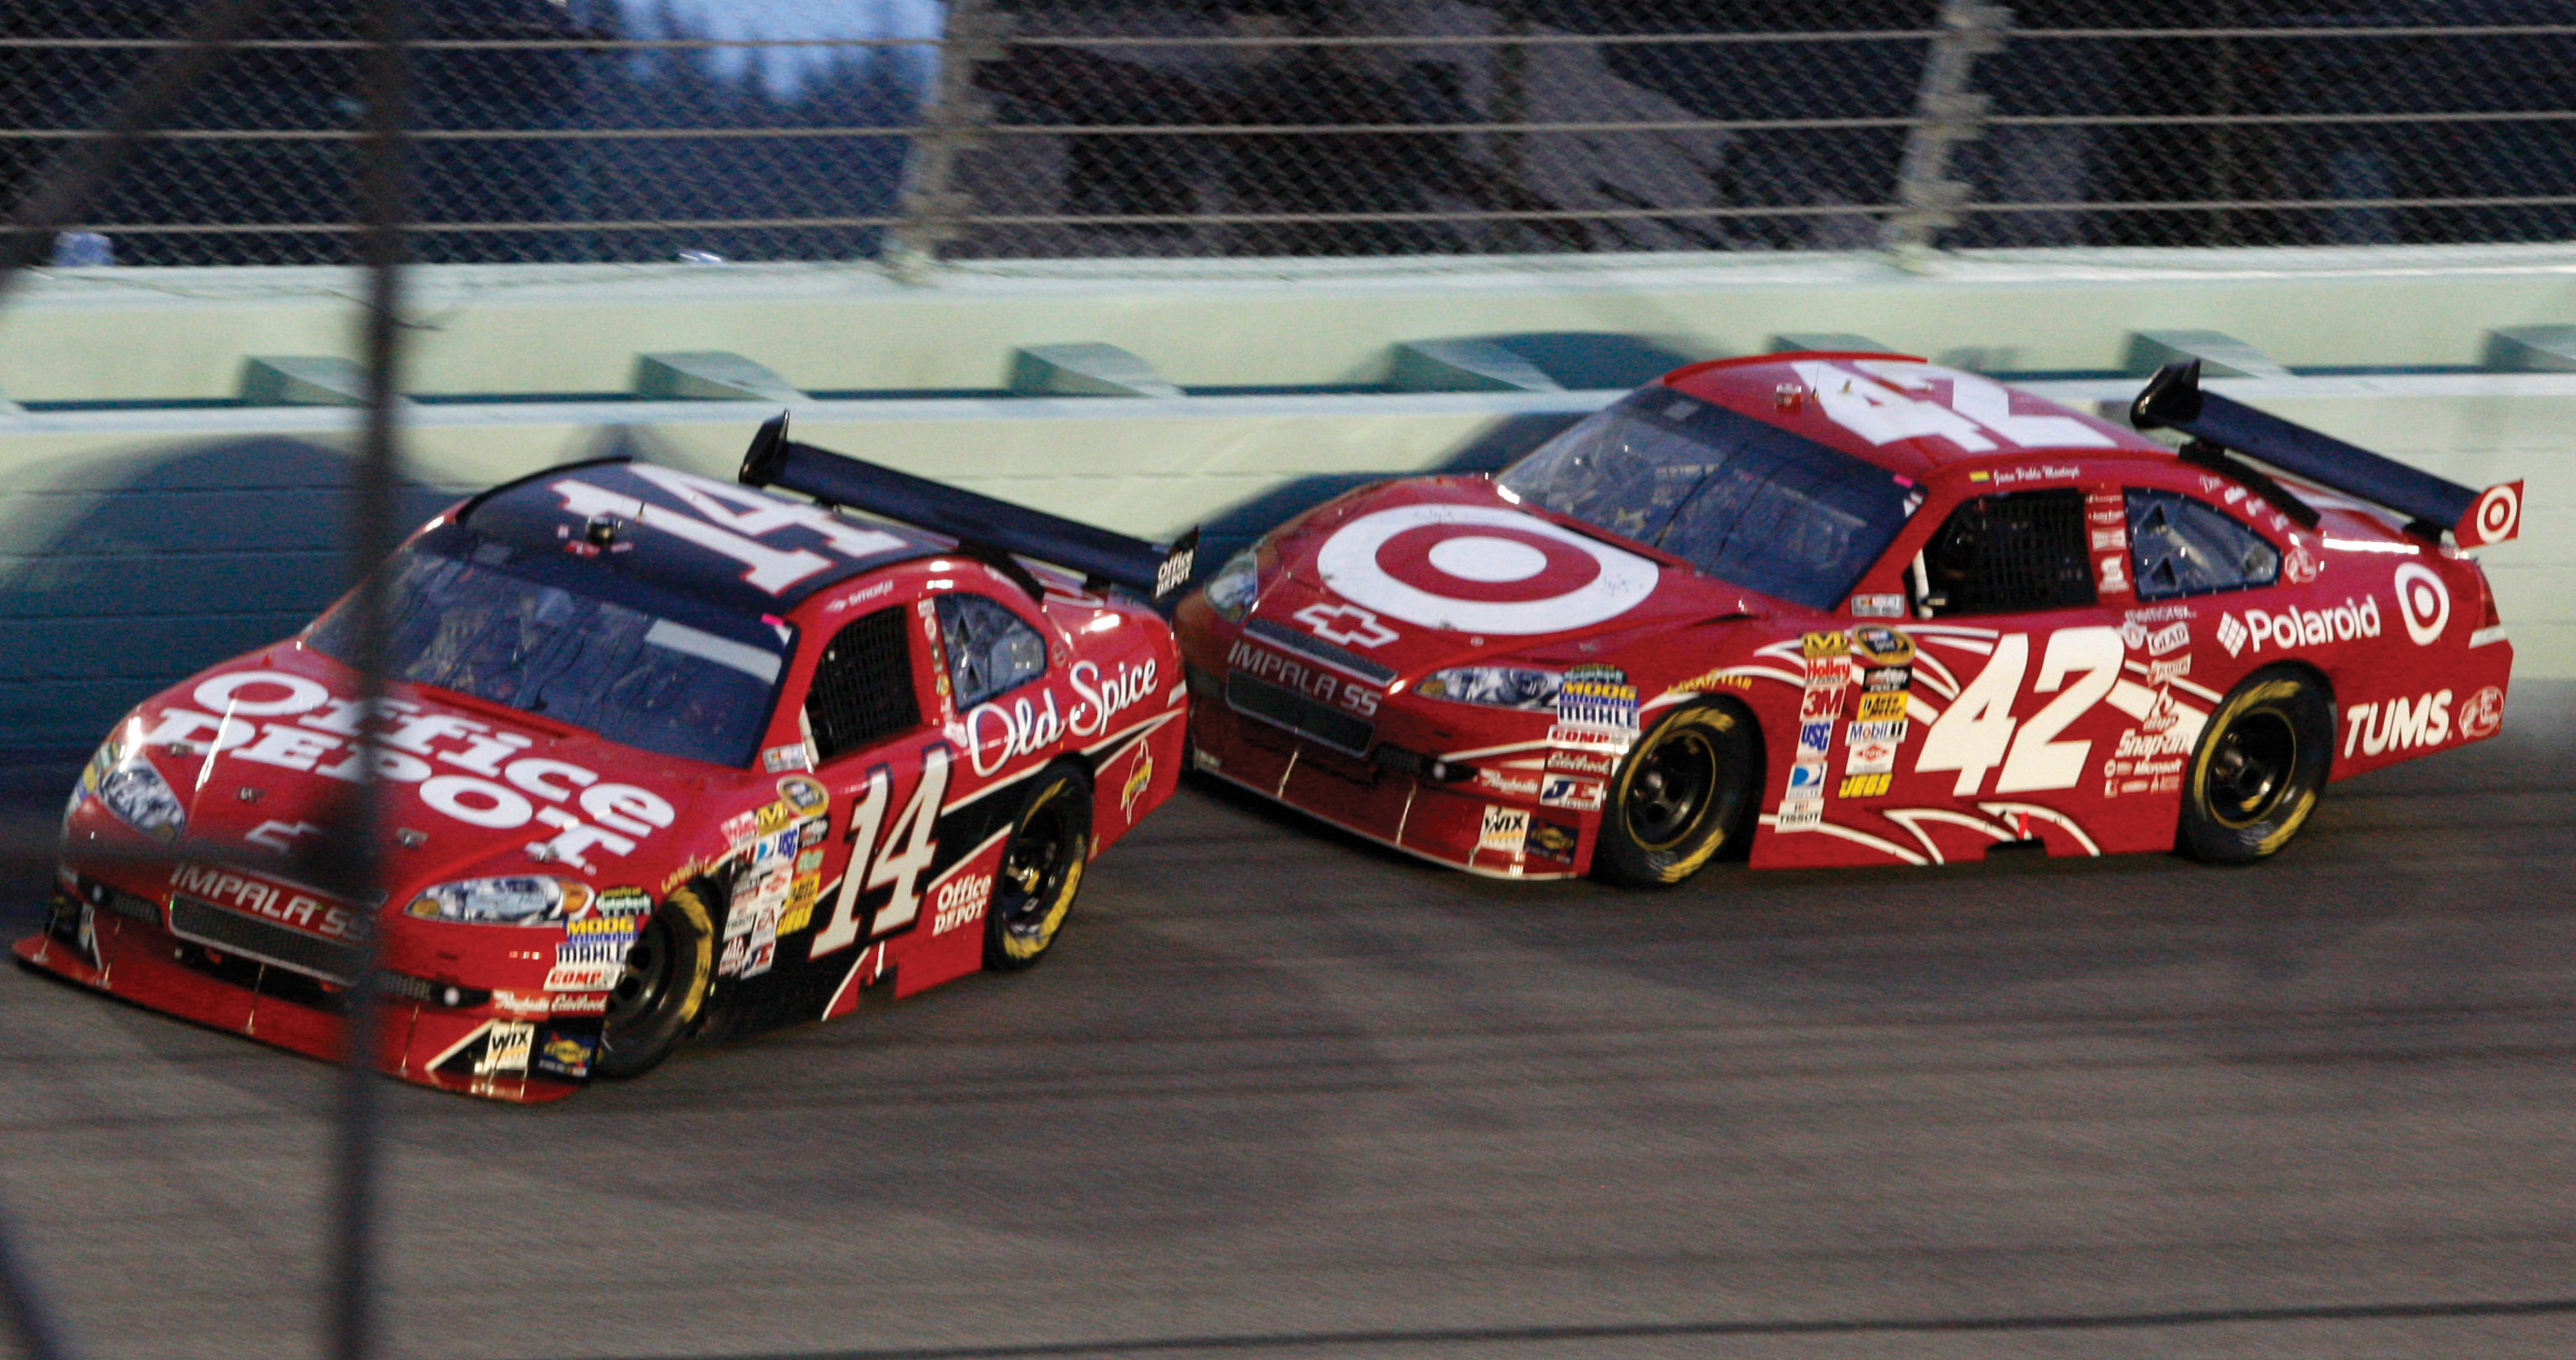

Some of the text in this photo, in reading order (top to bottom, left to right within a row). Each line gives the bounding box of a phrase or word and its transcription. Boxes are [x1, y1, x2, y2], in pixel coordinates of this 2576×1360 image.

[1790, 360, 2118, 452] 42
[550, 462, 911, 598] 14
[2151, 627, 2186, 651] GLAD
[2245, 594, 2381, 653] Polaroid
[1227, 640, 1383, 717] IMPALA SS
[1561, 682, 1637, 701] MOOG
[1803, 689, 1843, 716] 3M
[967, 658, 1158, 778] Old Spice
[1801, 723, 1831, 751] USG
[1850, 722, 1888, 740] Mobil
[1914, 626, 2125, 797] 42
[194, 671, 675, 837] Office
[142, 709, 637, 869] DEPOT
[809, 741, 952, 960] 14
[168, 861, 318, 927] IMPALA
[932, 896, 988, 936] DEPOT
[936, 873, 992, 913] Office
[567, 916, 635, 936] MOOG
[491, 1031, 528, 1052] WIX
